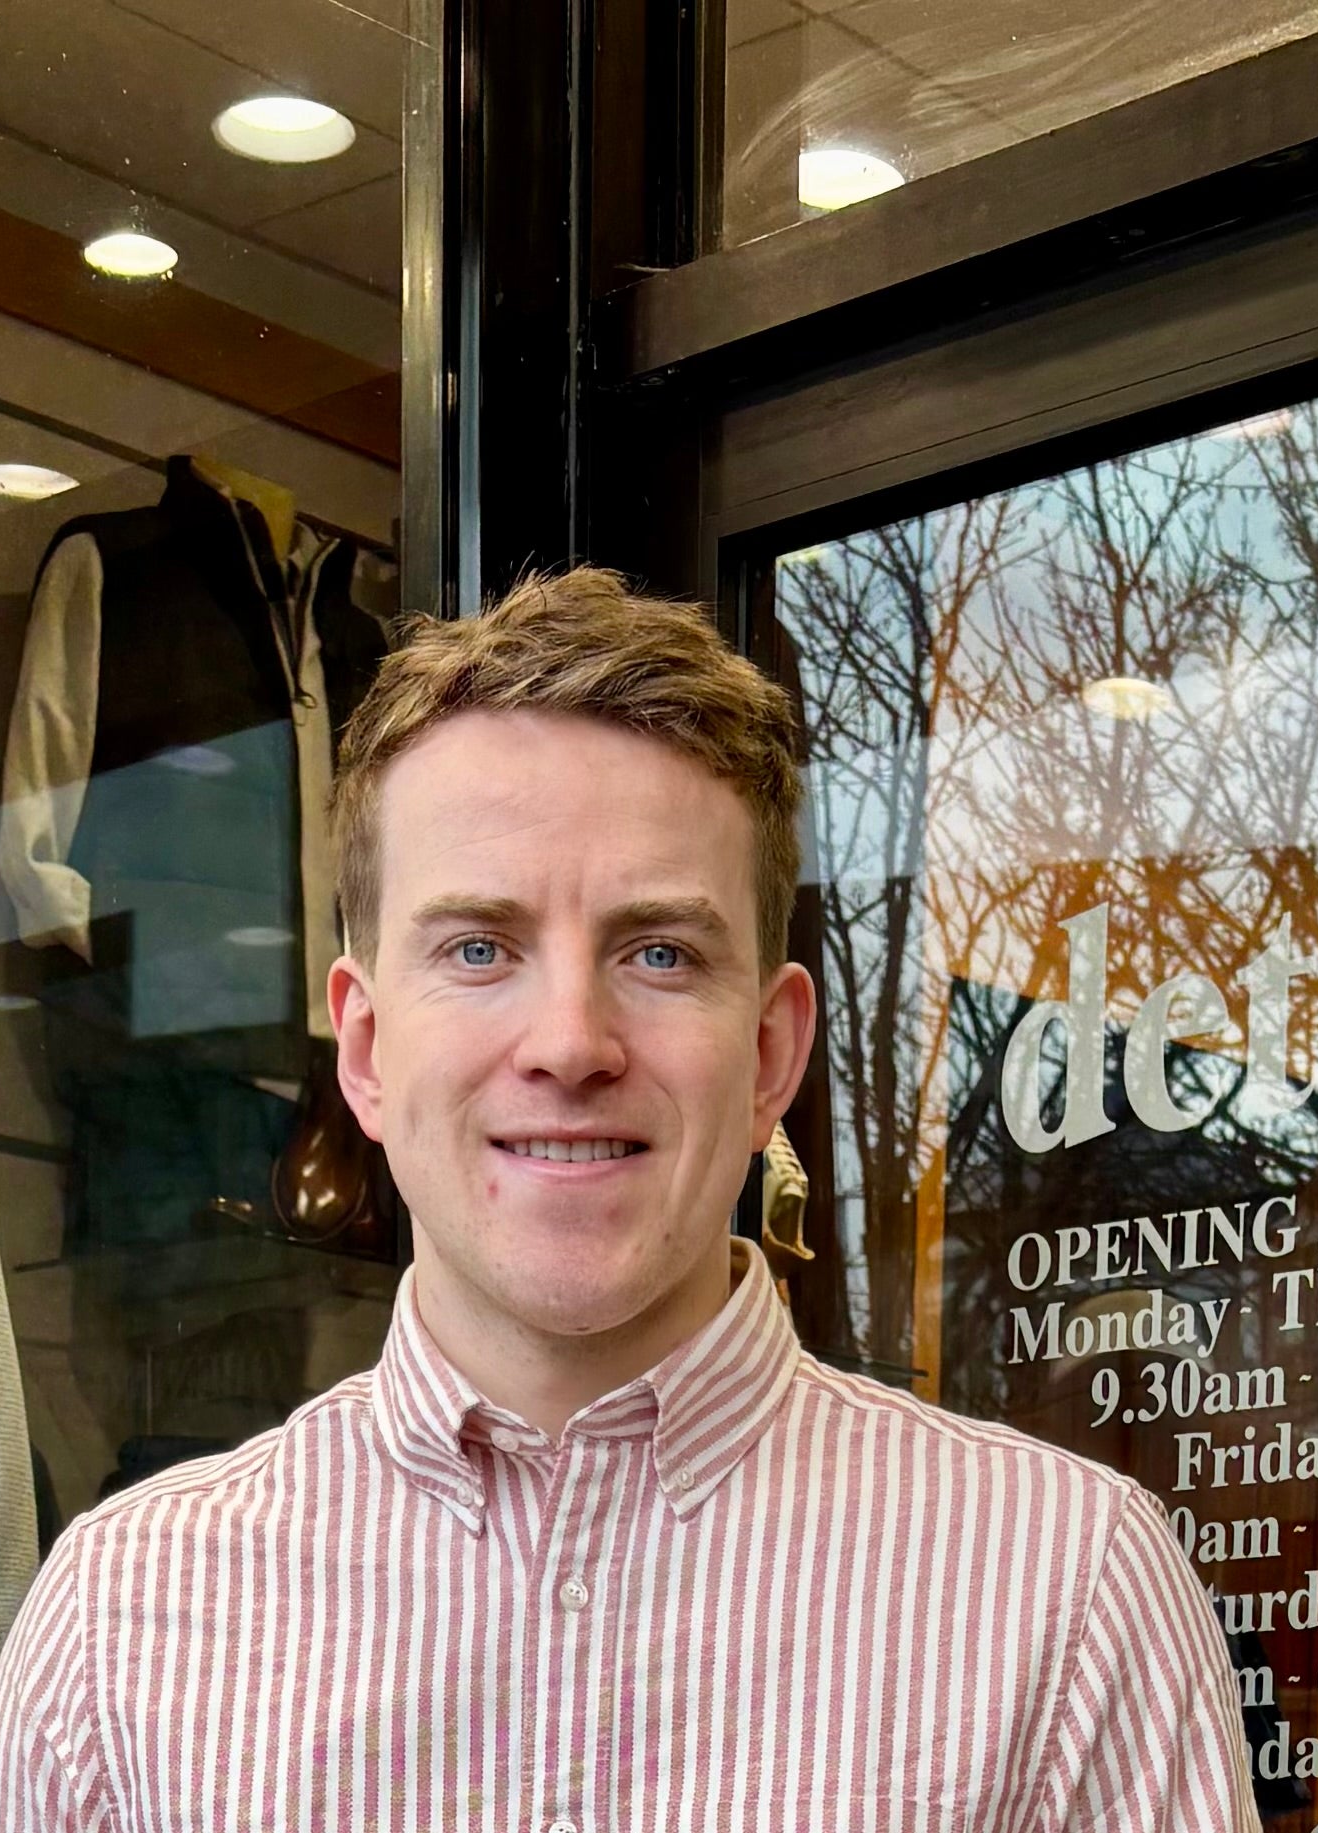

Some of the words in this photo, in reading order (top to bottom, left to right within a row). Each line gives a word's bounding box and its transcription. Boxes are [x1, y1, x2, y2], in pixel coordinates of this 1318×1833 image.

[1007, 1193, 1301, 1291] OPENING
[1008, 1290, 1232, 1365] Monday
[1090, 1359, 1287, 1429] 9.30am
[1170, 1505, 1281, 1564] 0am
